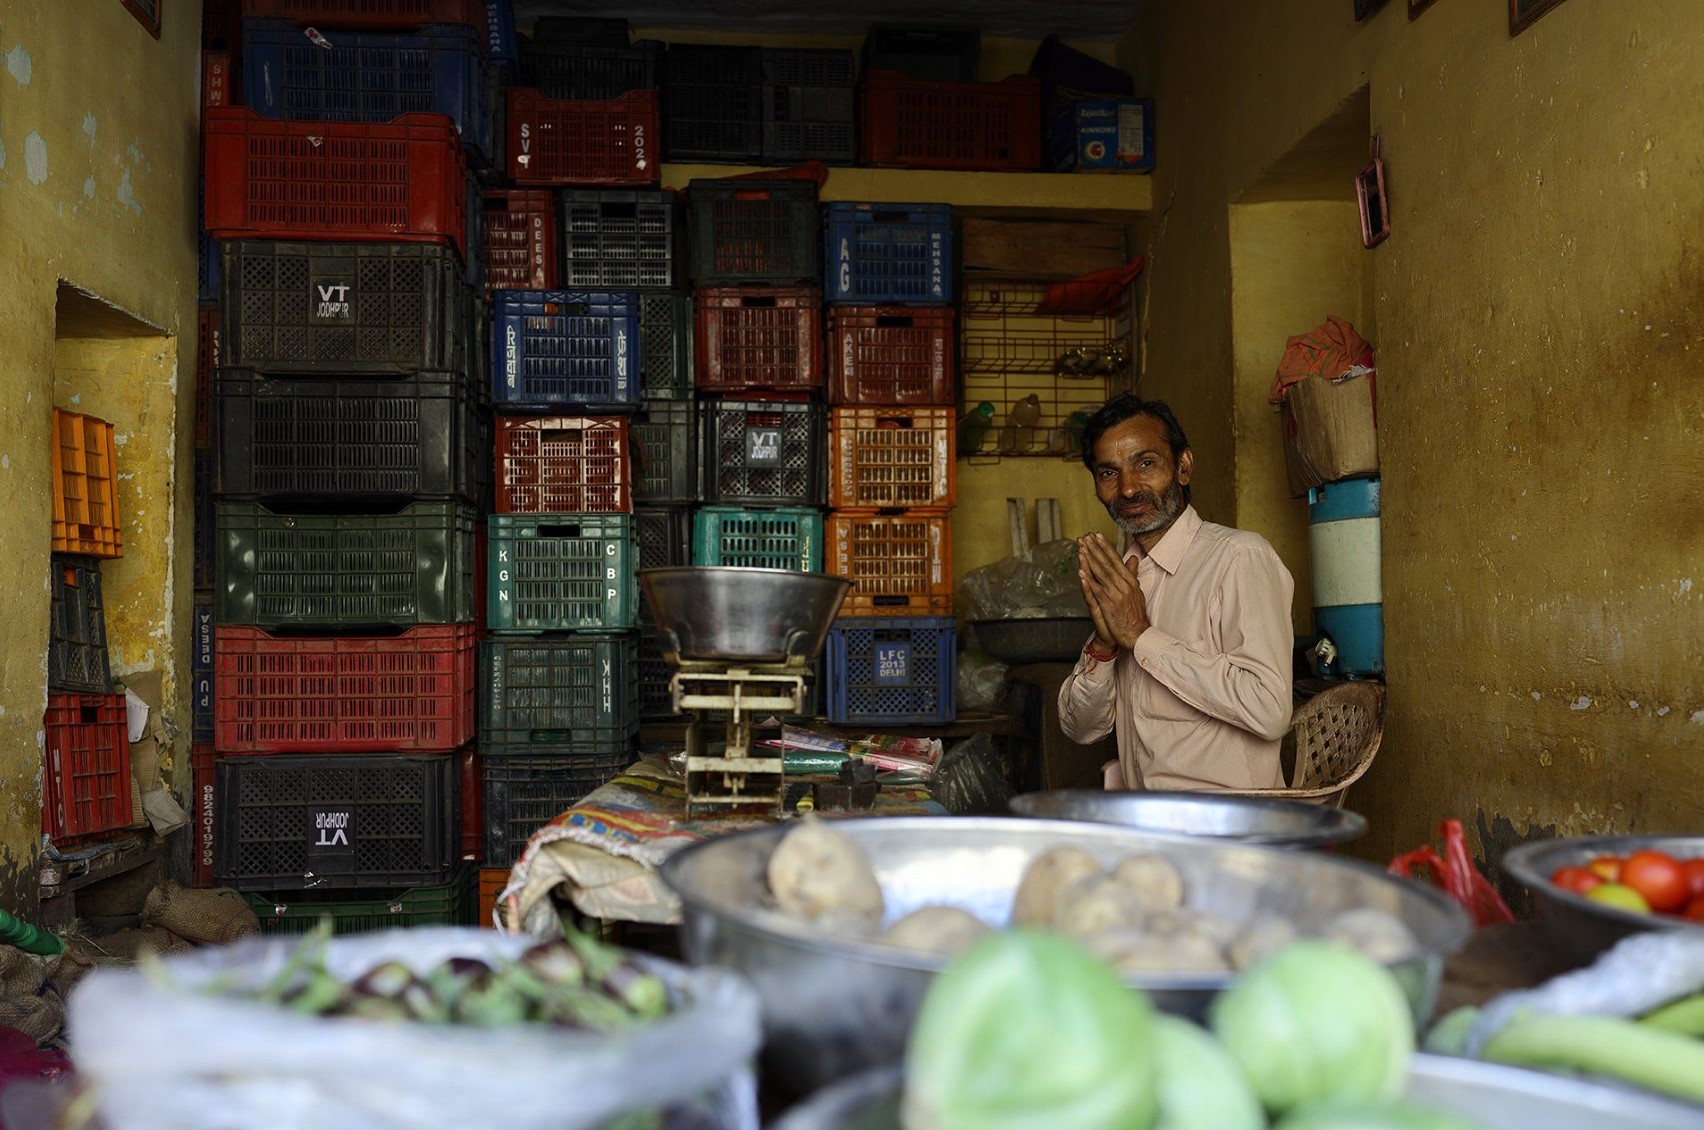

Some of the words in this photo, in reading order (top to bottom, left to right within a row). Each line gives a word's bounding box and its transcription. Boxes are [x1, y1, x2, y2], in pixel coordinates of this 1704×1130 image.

[634, 125, 647, 170] 202
[534, 218, 545, 278] DEESA
[931, 232, 942, 296] MEHSANA
[317, 284, 350, 302] VT
[751, 431, 778, 446] VT
[499, 550, 508, 601] KGN
[606, 544, 617, 600] CBP
[880, 660, 905, 668] 2013
[880, 668, 905, 677] DELHI
[315, 812, 349, 828] JODHPUR
[315, 828, 349, 845] VT
